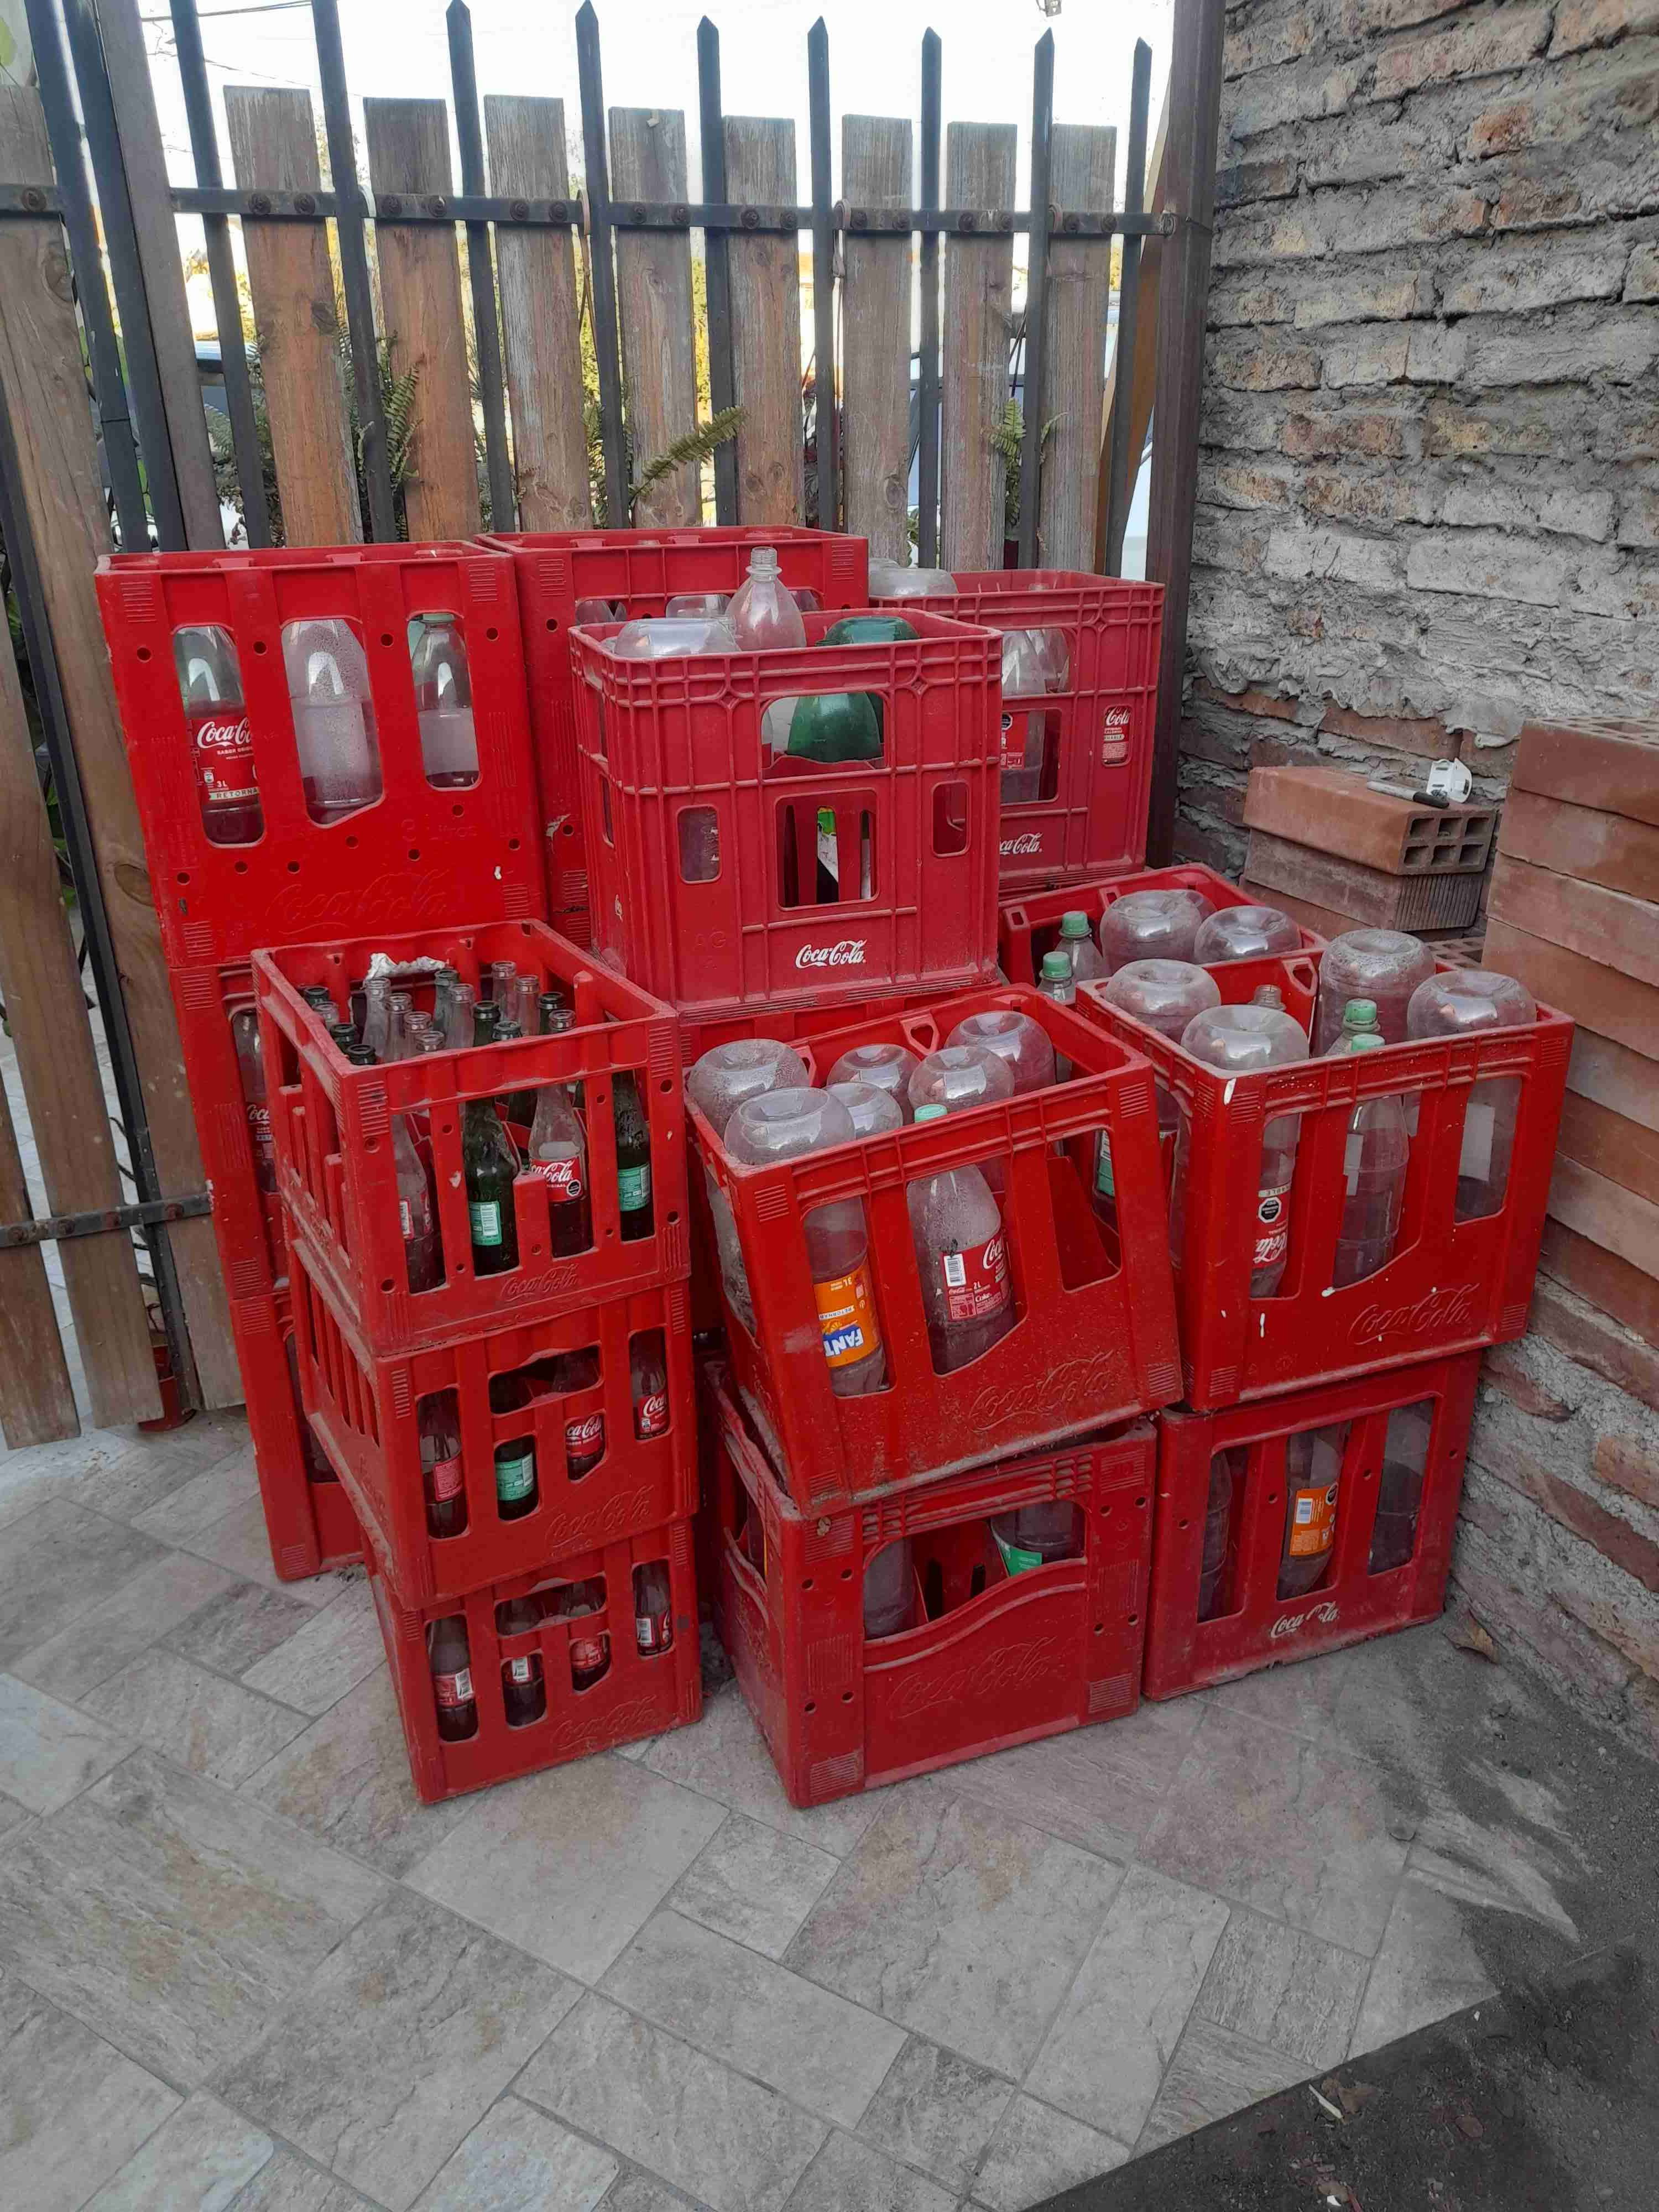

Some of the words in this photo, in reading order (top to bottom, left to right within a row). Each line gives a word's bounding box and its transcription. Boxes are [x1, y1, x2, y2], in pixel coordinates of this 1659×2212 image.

[197, 717, 252, 748] Coca-C
[217, 787, 258, 799] RETORNA
[1000, 832, 1043, 855] ca-Cola
[264, 869, 455, 934] Coca-Cola
[795, 939, 867, 968] Coca-Cola
[531, 1160, 575, 1183] ca-Cola
[500, 1264, 578, 1302] Coca-Cola
[819, 1307, 852, 1319] RETORNAB
[1347, 1283, 1480, 1345] Coca-Cola
[823, 1328, 864, 1357] FANT
[968, 1349, 1115, 1433] Coca-Cola
[545, 1485, 654, 1547] Coca-Cola
[886, 1636, 1057, 1720] Coca-Cola
[550, 1695, 657, 1750] Coca-Cola
